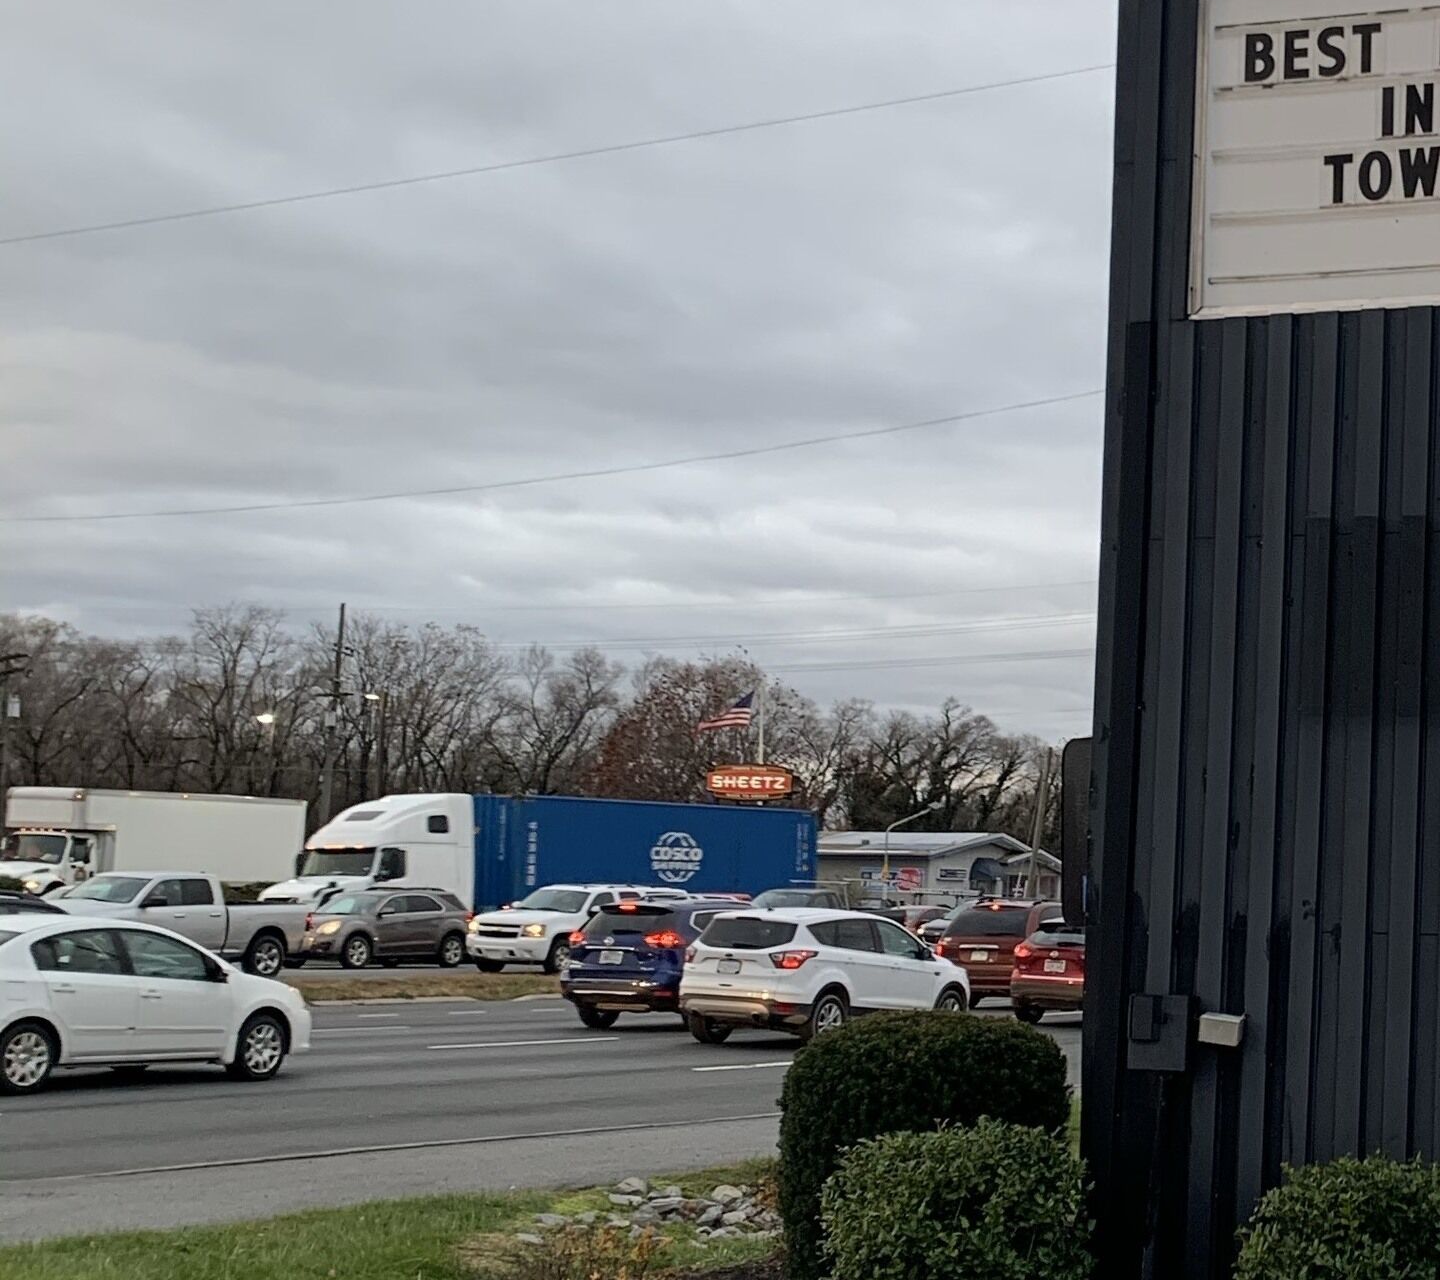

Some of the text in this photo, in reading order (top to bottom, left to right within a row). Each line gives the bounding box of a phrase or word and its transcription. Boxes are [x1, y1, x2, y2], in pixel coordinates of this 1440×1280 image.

[1244, 23, 1382, 82] BEST
[1381, 83, 1434, 136] IN
[711, 775, 785, 789] SHEETZ
[650, 847, 704, 861] COSCO
